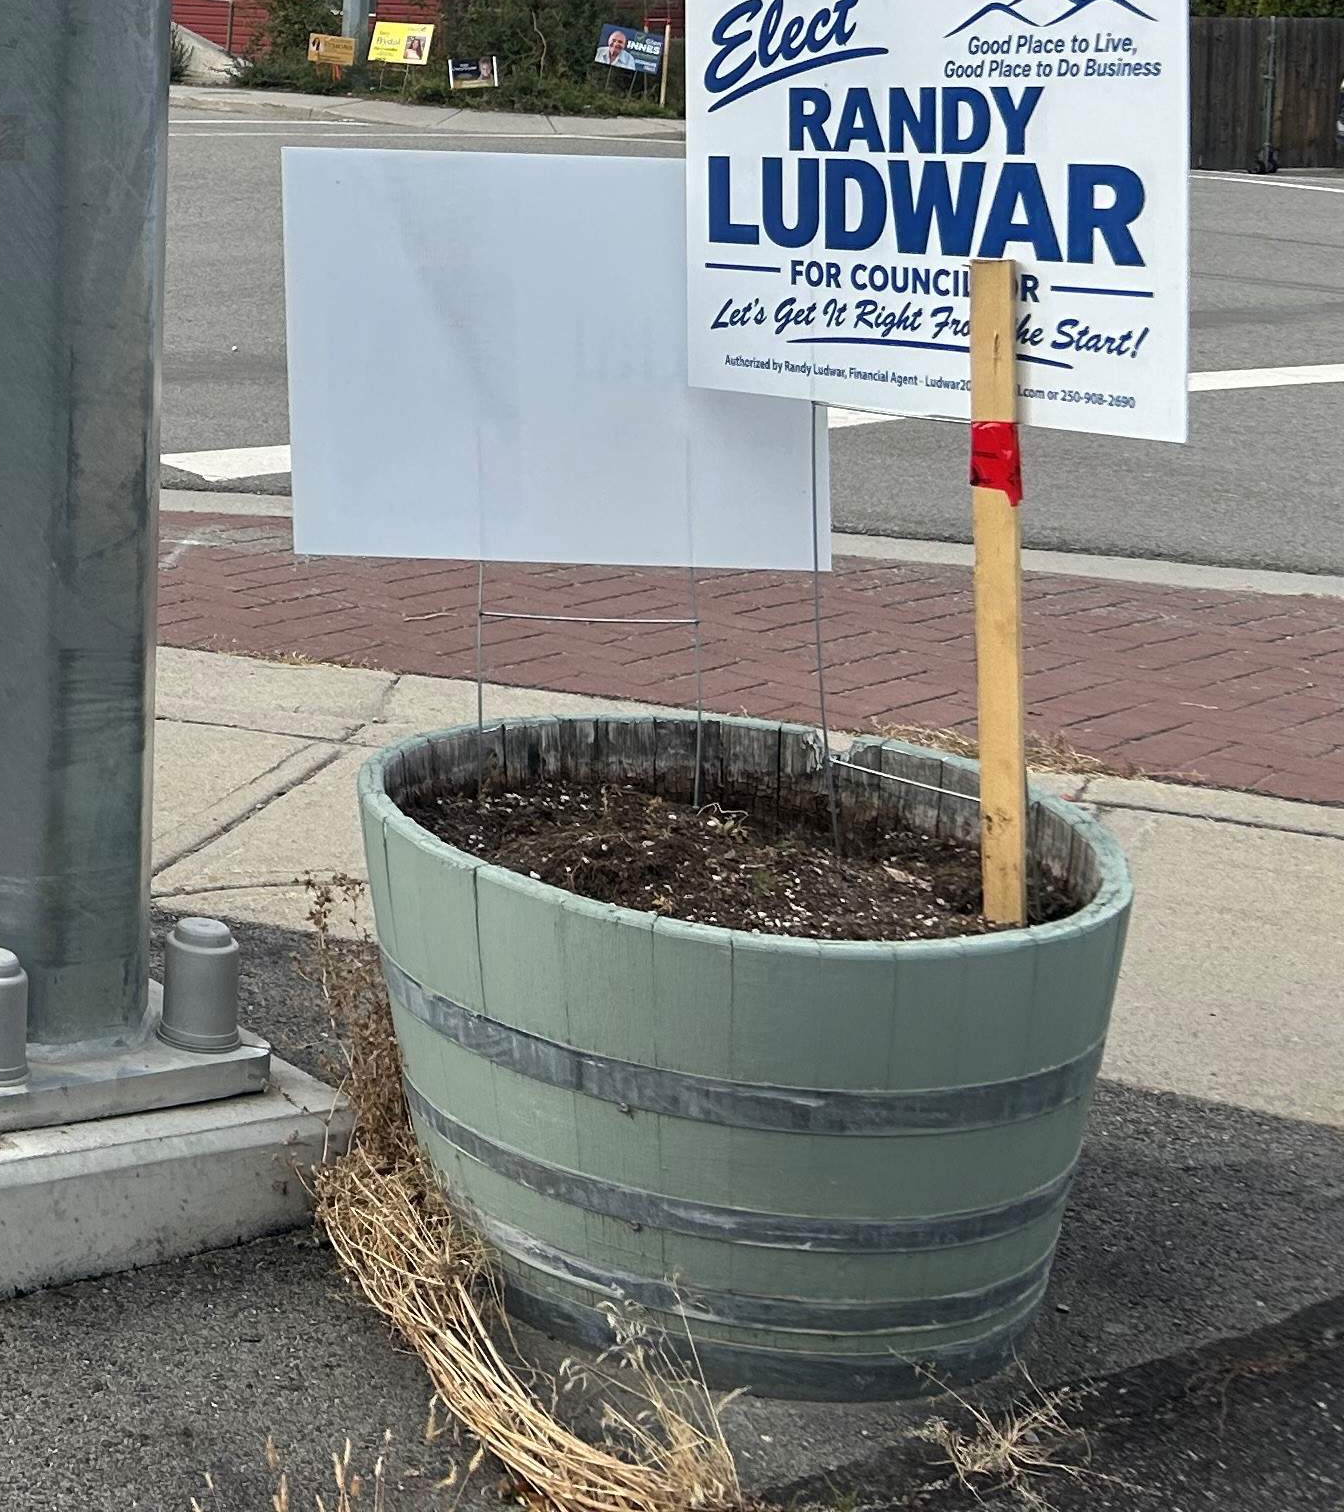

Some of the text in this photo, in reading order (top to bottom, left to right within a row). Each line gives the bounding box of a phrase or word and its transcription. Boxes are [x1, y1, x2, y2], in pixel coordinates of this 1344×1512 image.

[967, 33, 1138, 55] Good Place to Live,
[943, 57, 1162, 79] Good Place to Do Business
[788, 86, 1046, 156] RANDY
[708, 155, 1147, 268] LUDWAR
[790, 260, 842, 289] FOR
[710, 297, 1150, 359] Let's Get It Right Fro he Start!
[725, 354, 771, 370] Authorized
[772, 361, 783, 374] by
[784, 360, 812, 377] Randy
[848, 367, 889, 382] Financial
[890, 372, 918, 387] Agent
[1047, 390, 1059, 401] or
